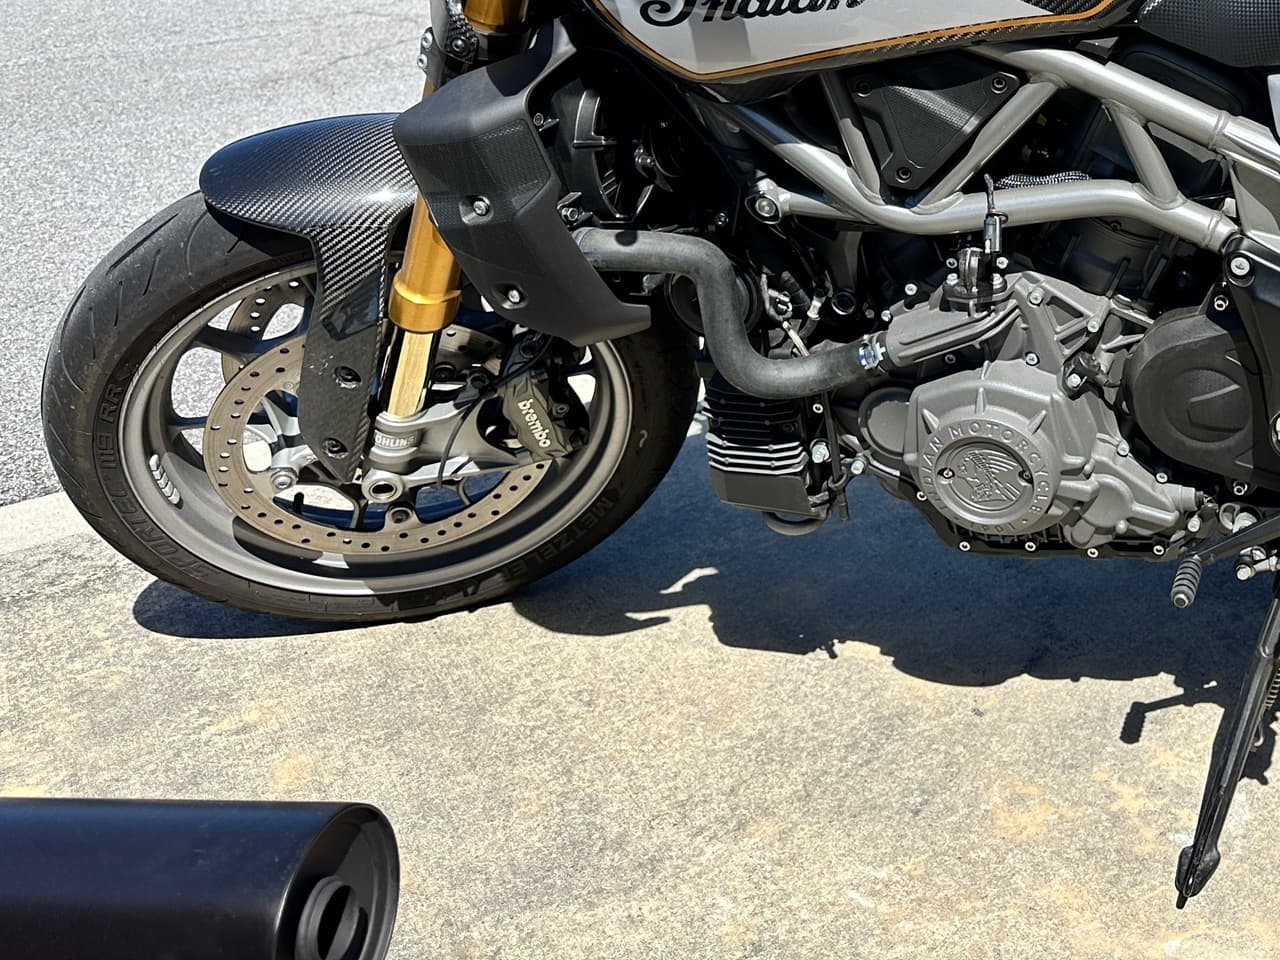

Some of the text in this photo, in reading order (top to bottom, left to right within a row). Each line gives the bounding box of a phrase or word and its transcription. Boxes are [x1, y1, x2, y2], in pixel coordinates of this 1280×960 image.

[100, 383, 123, 425] RR
[518, 398, 551, 448] brembo
[948, 422, 1049, 514] MOTORCYCLE
